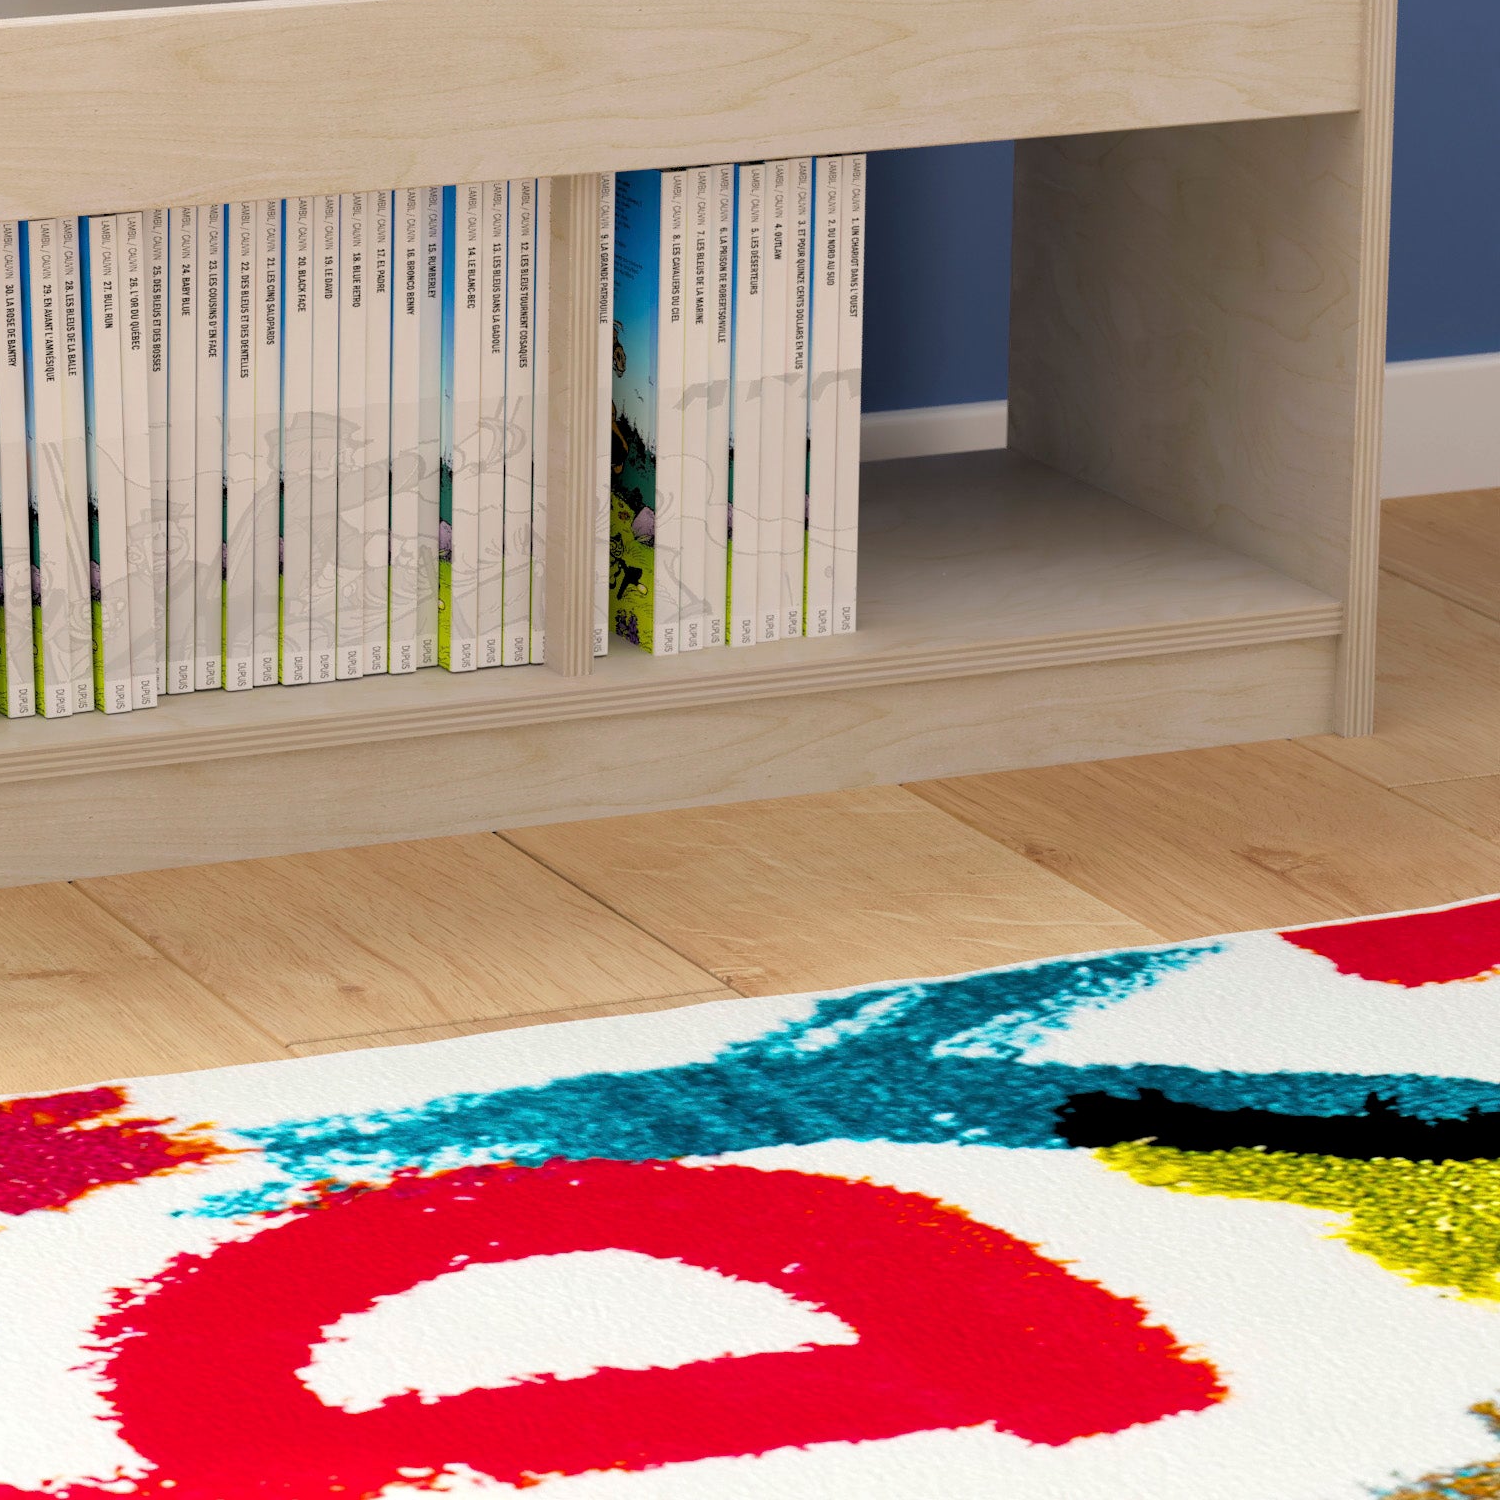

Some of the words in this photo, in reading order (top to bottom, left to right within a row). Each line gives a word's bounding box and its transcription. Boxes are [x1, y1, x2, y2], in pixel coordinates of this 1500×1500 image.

[521, 181, 530, 206] LAMBIL
[520, 212, 530, 236] CAUVIN
[751, 227, 759, 235] 5.
[774, 223, 782, 231] 4.
[851, 225, 860, 236] UN
[520, 241, 529, 253] 12.
[672, 243, 681, 256] LES
[750, 236, 759, 249] LES
[774, 231, 783, 260] OUTLAW
[850, 236, 859, 267] CHARIOT
[297, 256, 307, 268] 20.
[324, 256, 333, 267] 19.
[406, 248, 415, 259] 16.
[520, 254, 529, 267] LES
[182, 263, 190, 275] 24.
[324, 268, 333, 277] LE
[406, 260, 415, 290] BRONCO
[671, 256, 680, 295] CAVALIERS
[749, 250, 759, 295] DÉSERTEURS
[849, 268, 859, 287] DANS
[129, 277, 138, 290] 26.
[181, 277, 190, 295] BABY
[297, 269, 306, 293] BLACK
[324, 277, 333, 299] DAVID
[520, 268, 529, 291] BLEUS
[43, 284, 52, 297] 29.
[129, 290, 139, 308] L'OR
[43, 297, 52, 307] EN
[181, 297, 190, 316] BLUE
[297, 294, 306, 312] FACE
[406, 291, 415, 315] BENNY
[671, 295, 680, 306] DU
[849, 288, 858, 317] L'OUEST
[44, 308, 53, 331] AVANT
[130, 308, 139, 320] DU
[519, 292, 528, 329] TOURNENT
[671, 307, 680, 323] CIEL
[129, 321, 141, 350] QUÉBEC
[44, 332, 56, 382] L'AMNÉSIQUE
[518, 330, 528, 368] COSAQUES
[841, 607, 850, 630] DUPUIS
[742, 620, 750, 644] DUPUIS
[293, 656, 304, 681] DUPUIS
